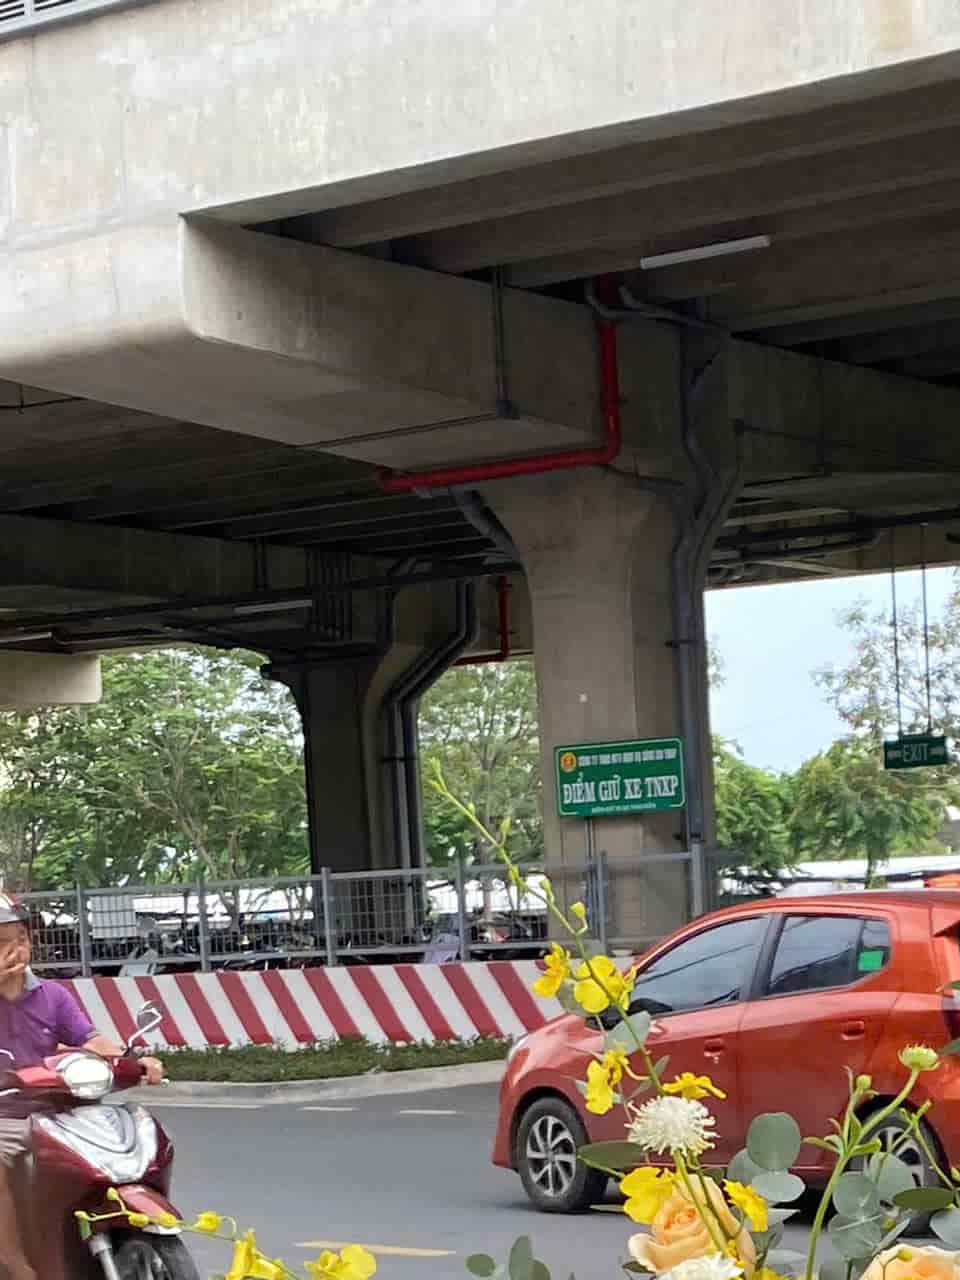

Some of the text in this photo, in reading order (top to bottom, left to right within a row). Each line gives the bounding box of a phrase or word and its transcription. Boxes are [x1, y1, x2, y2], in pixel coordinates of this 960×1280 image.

[903, 743, 928, 762] EXIT
[563, 772, 595, 804] ĐIỂM
[624, 778, 642, 800] XE
[645, 775, 679, 798] TNXP
